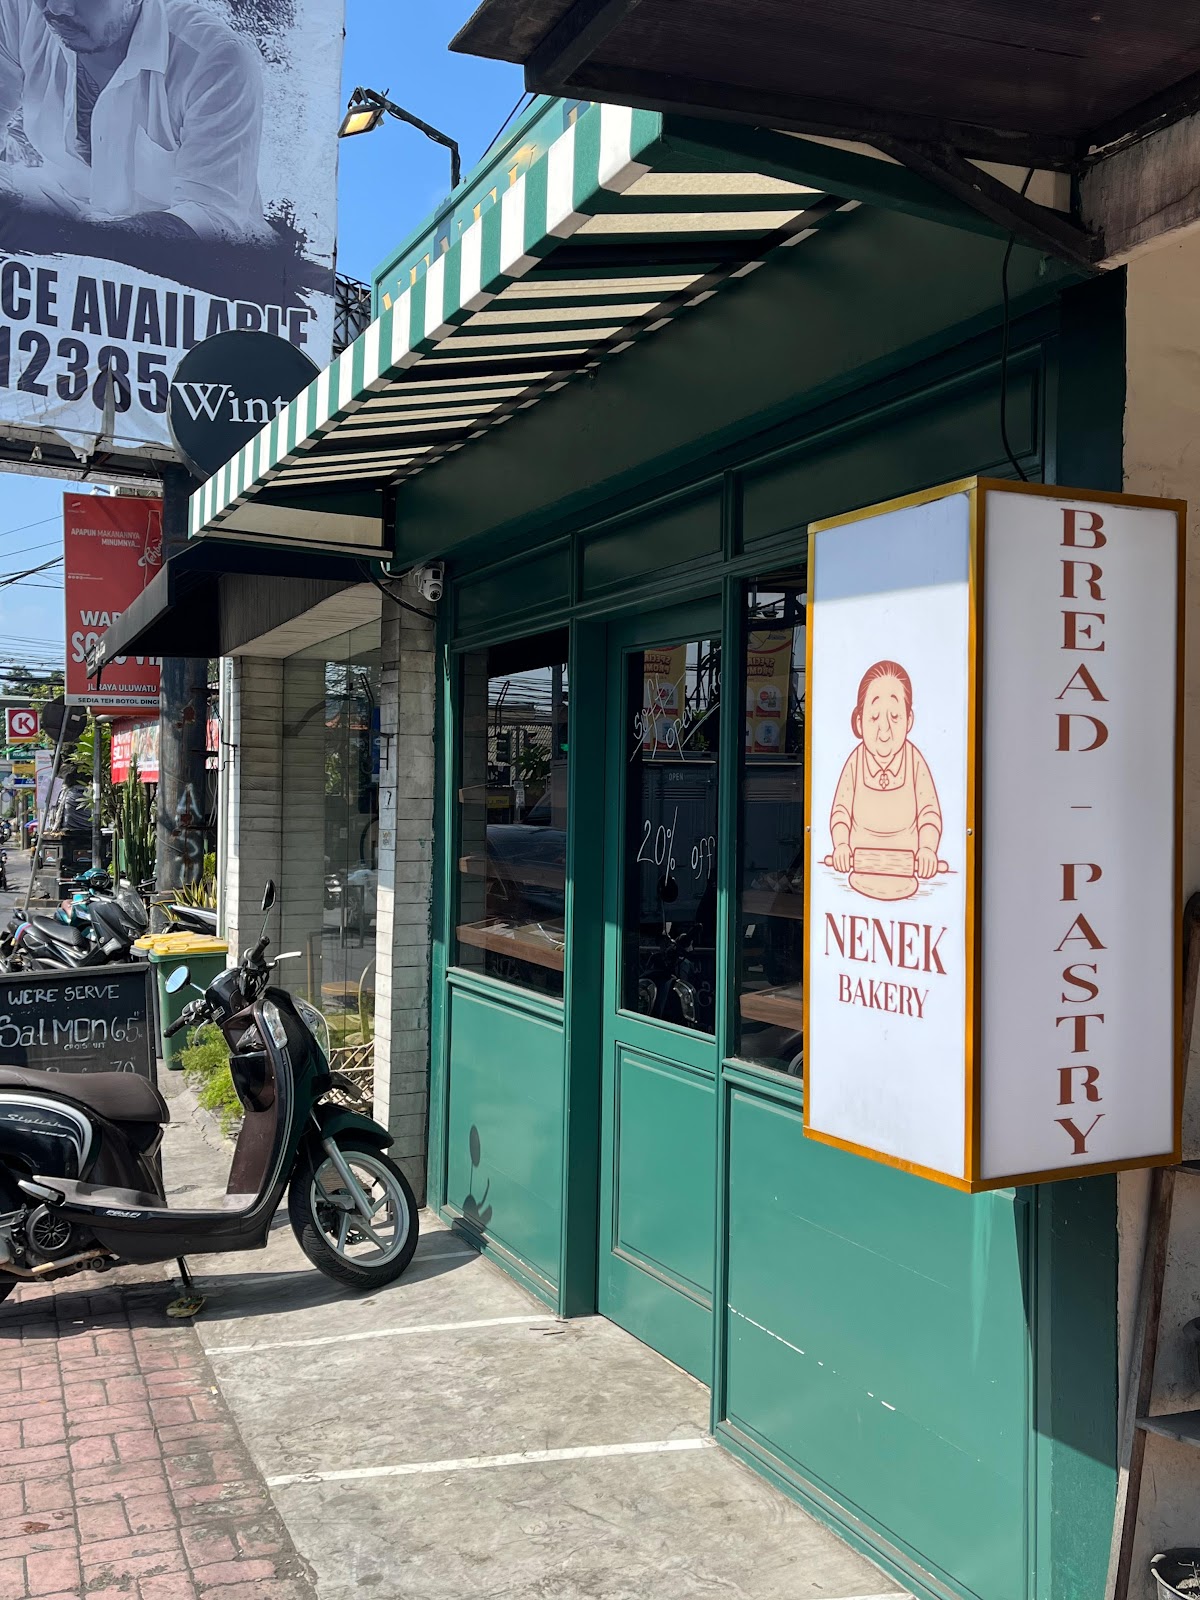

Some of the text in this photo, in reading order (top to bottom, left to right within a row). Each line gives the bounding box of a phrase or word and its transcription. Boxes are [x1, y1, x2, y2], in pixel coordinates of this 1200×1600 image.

[2, 261, 58, 327] CE
[71, 528, 140, 539] APAPUN MAKANANNYA
[1054, 508, 1109, 751] BREAD
[119, 684, 156, 693] ULUWATU
[18, 717, 34, 734] K
[669, 772, 684, 781] OPEN
[637, 806, 678, 887] 20%
[825, 912, 947, 975] NENEK
[64, 984, 120, 1001] SERVE
[839, 974, 929, 1019] BAKERY
[1053, 863, 1108, 1155] PASTRY
